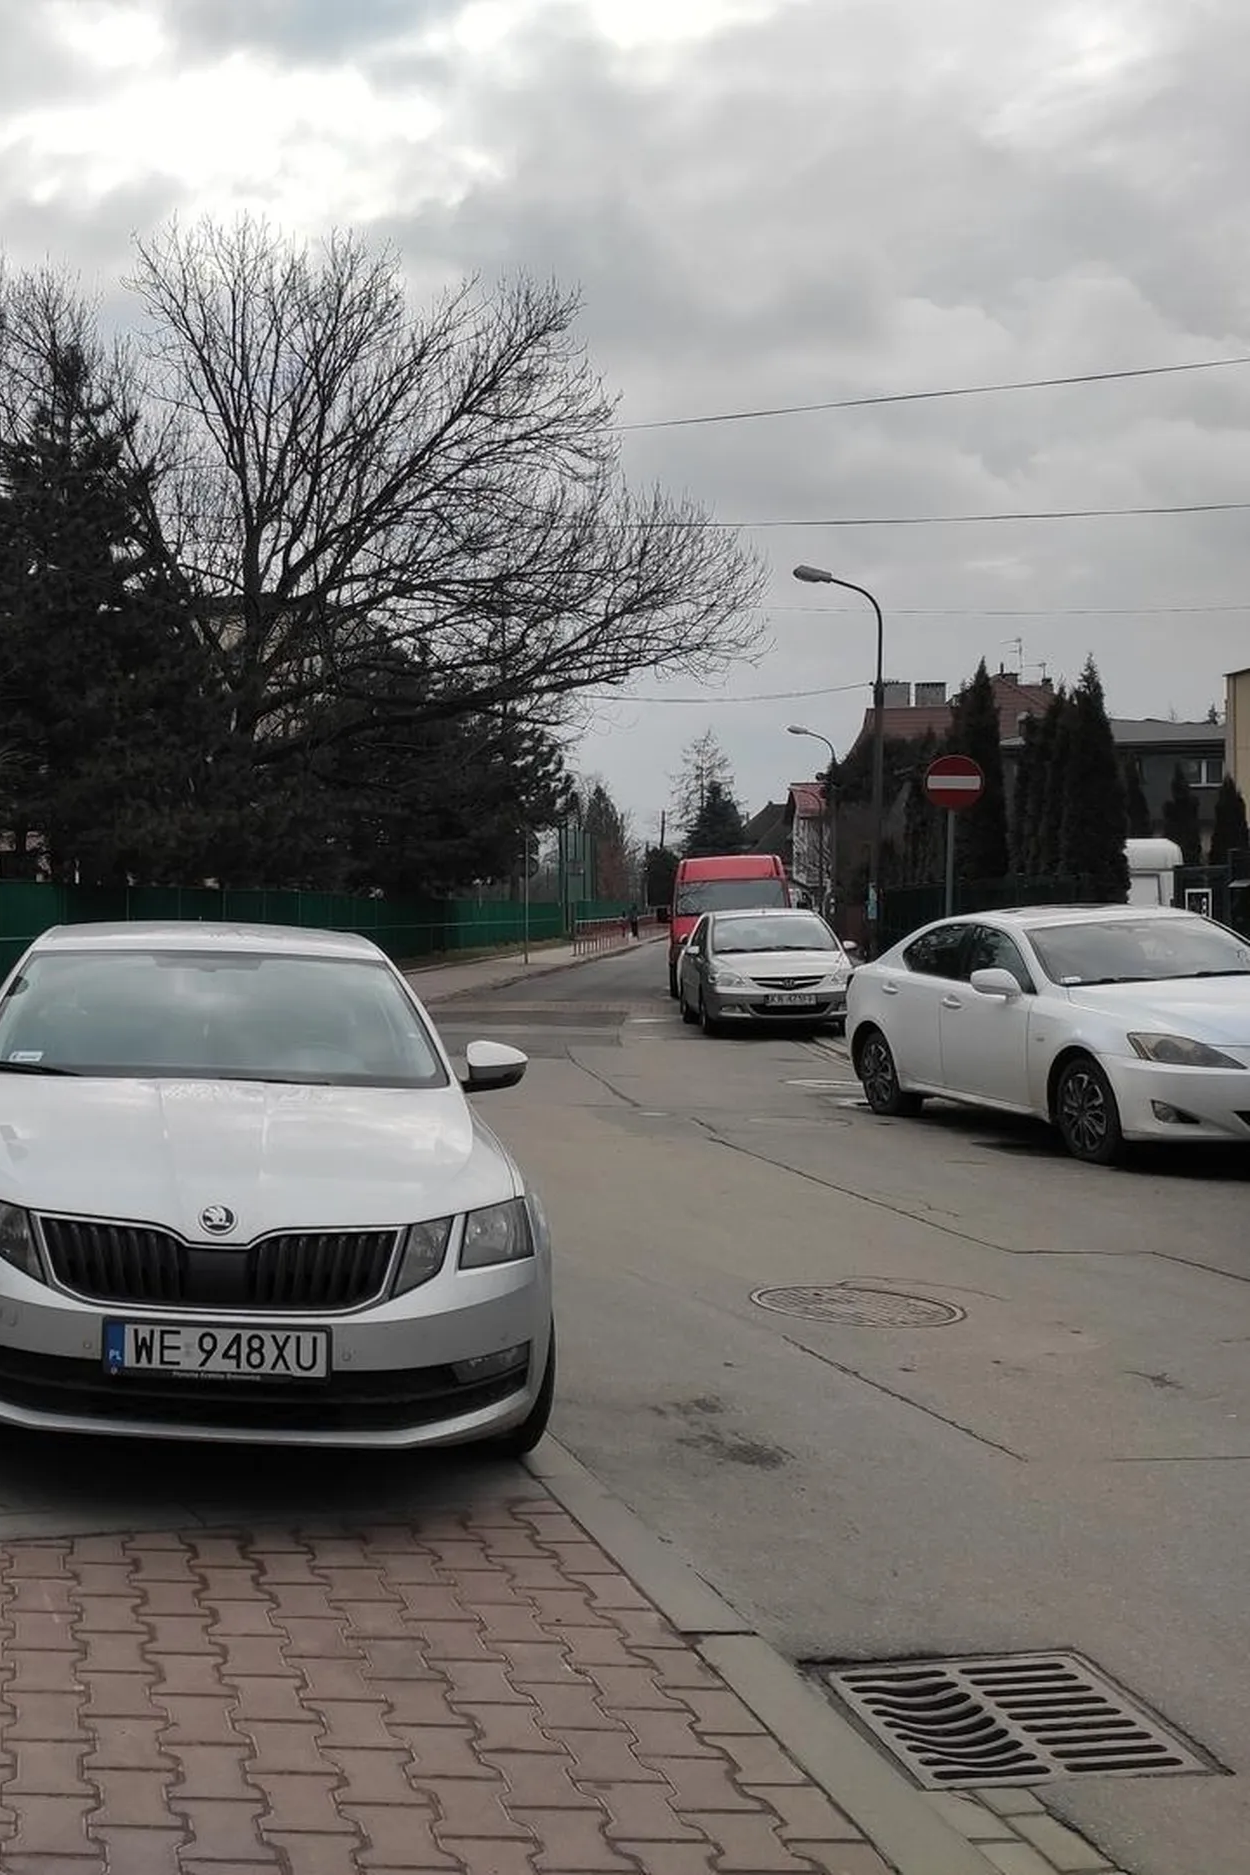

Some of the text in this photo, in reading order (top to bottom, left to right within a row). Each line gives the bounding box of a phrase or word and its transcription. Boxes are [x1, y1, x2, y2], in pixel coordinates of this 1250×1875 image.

[108, 1349, 122, 1361] PL
[133, 1328, 318, 1372] WE 948XU
